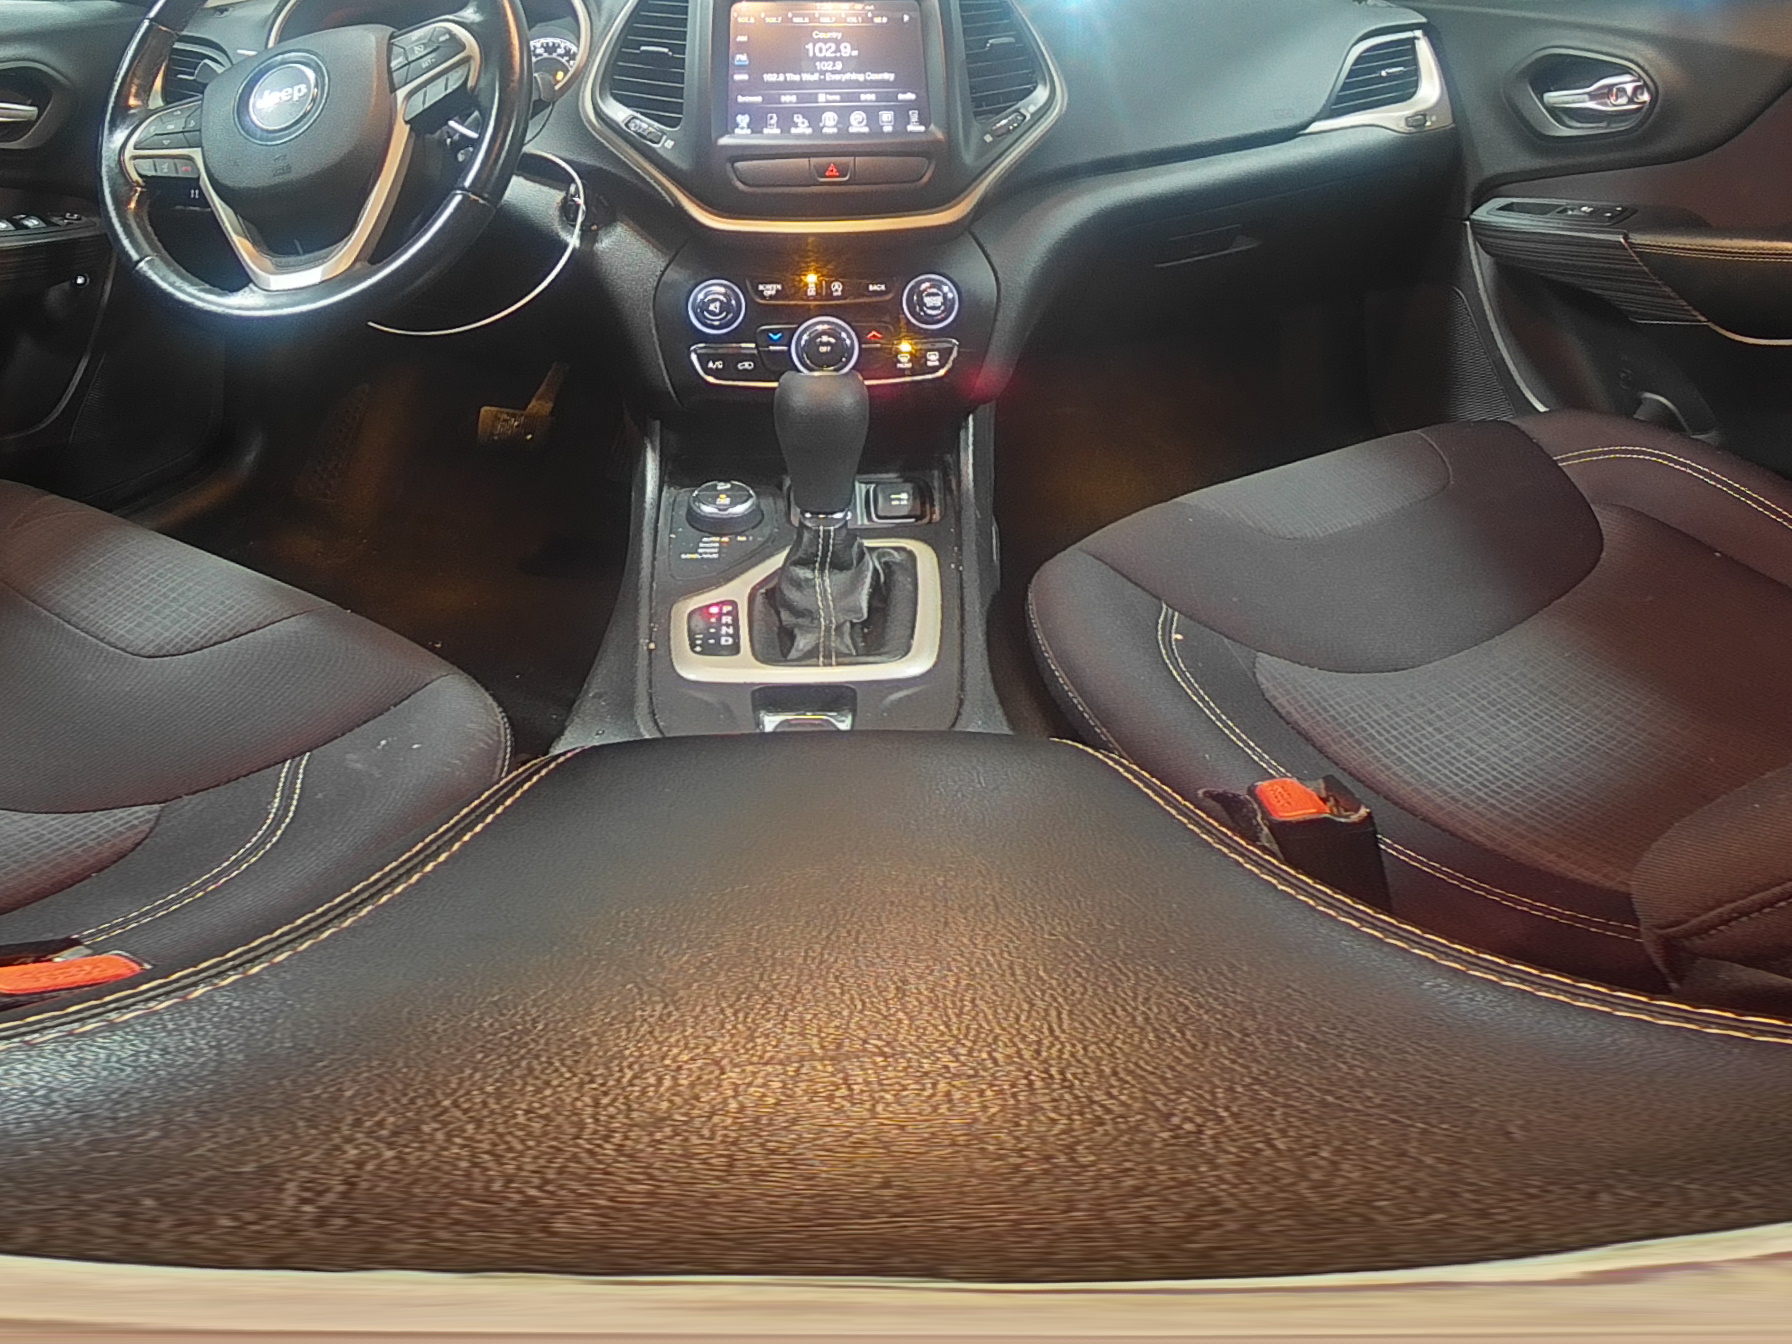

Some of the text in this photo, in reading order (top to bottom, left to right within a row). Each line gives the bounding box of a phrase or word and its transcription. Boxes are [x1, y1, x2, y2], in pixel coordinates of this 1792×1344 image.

[812, 30, 842, 40] Country
[805, 42, 851, 57] 102.9
[815, 61, 842, 71] 102.9
[786, 73, 800, 81] The
[826, 72, 864, 82] Everything
[866, 71, 895, 82] Country
[257, 83, 307, 109] Jeep
[708, 360, 723, 369] A/C
[721, 616, 732, 624] R
[720, 626, 733, 634] N
[720, 636, 733, 645] D
